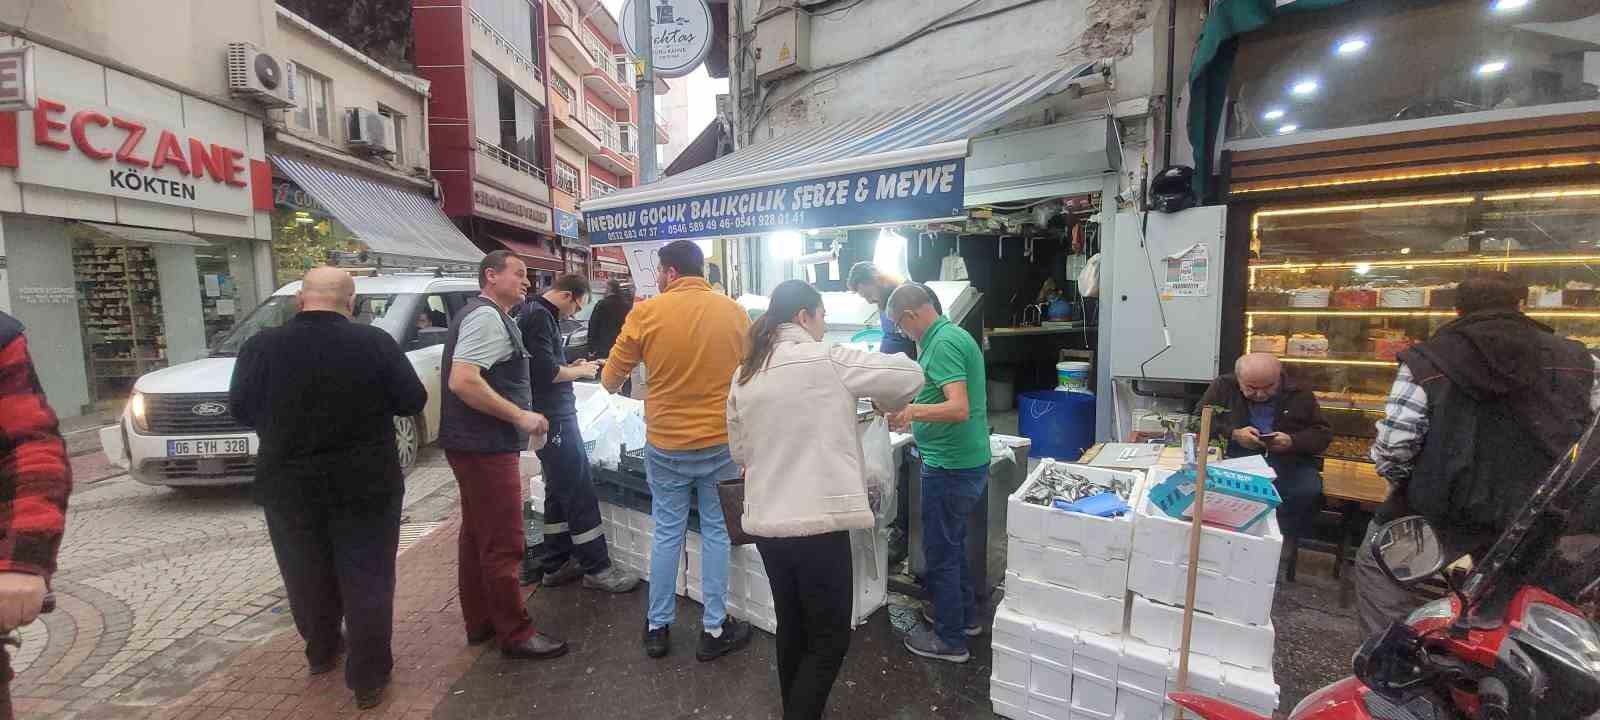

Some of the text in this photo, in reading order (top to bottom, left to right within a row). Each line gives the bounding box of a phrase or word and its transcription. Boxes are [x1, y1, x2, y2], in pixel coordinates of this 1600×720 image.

[33, 96, 247, 188] ECZANE
[110, 168, 195, 201] KÖKTEN
[791, 179, 850, 210] SEBZE
[854, 177, 869, 202] &
[875, 164, 957, 200] MEYVE
[689, 221, 705, 232] 589
[706, 219, 717, 230] 49
[758, 214, 774, 226] 928
[196, 441, 217, 453] EYH
[224, 439, 245, 453] 328
